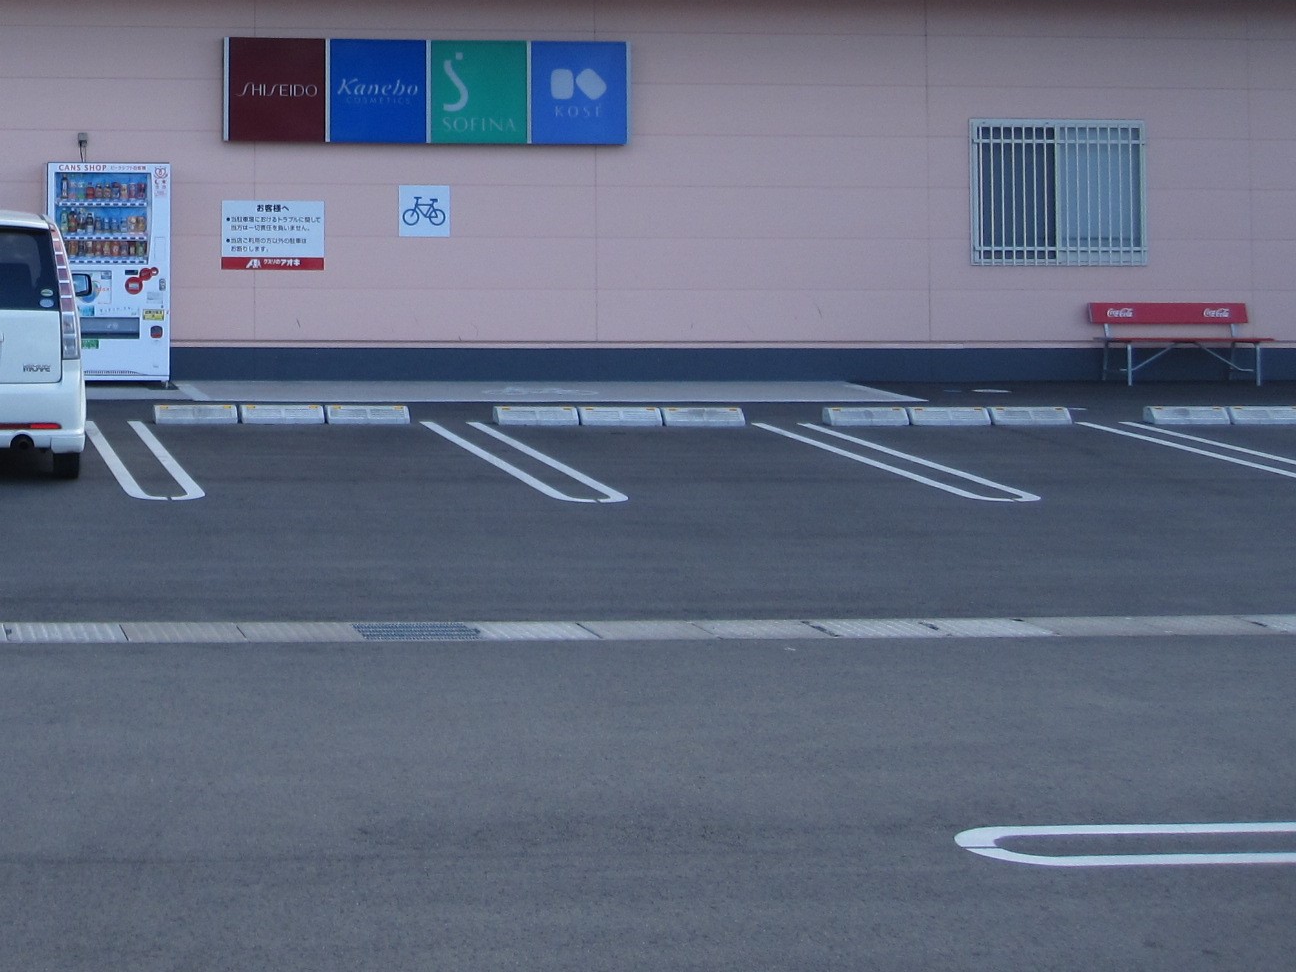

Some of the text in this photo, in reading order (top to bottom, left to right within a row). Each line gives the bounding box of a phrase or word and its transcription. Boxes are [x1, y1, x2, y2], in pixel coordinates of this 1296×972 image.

[235, 81, 318, 98] SHISEIDO
[337, 77, 418, 96] Kanebo
[346, 96, 411, 105] COSMETICS
[442, 116, 516, 133] SOFINA
[256, 204, 290, 213] お客様へ
[264, 259, 301, 267] クスリのアオキ
